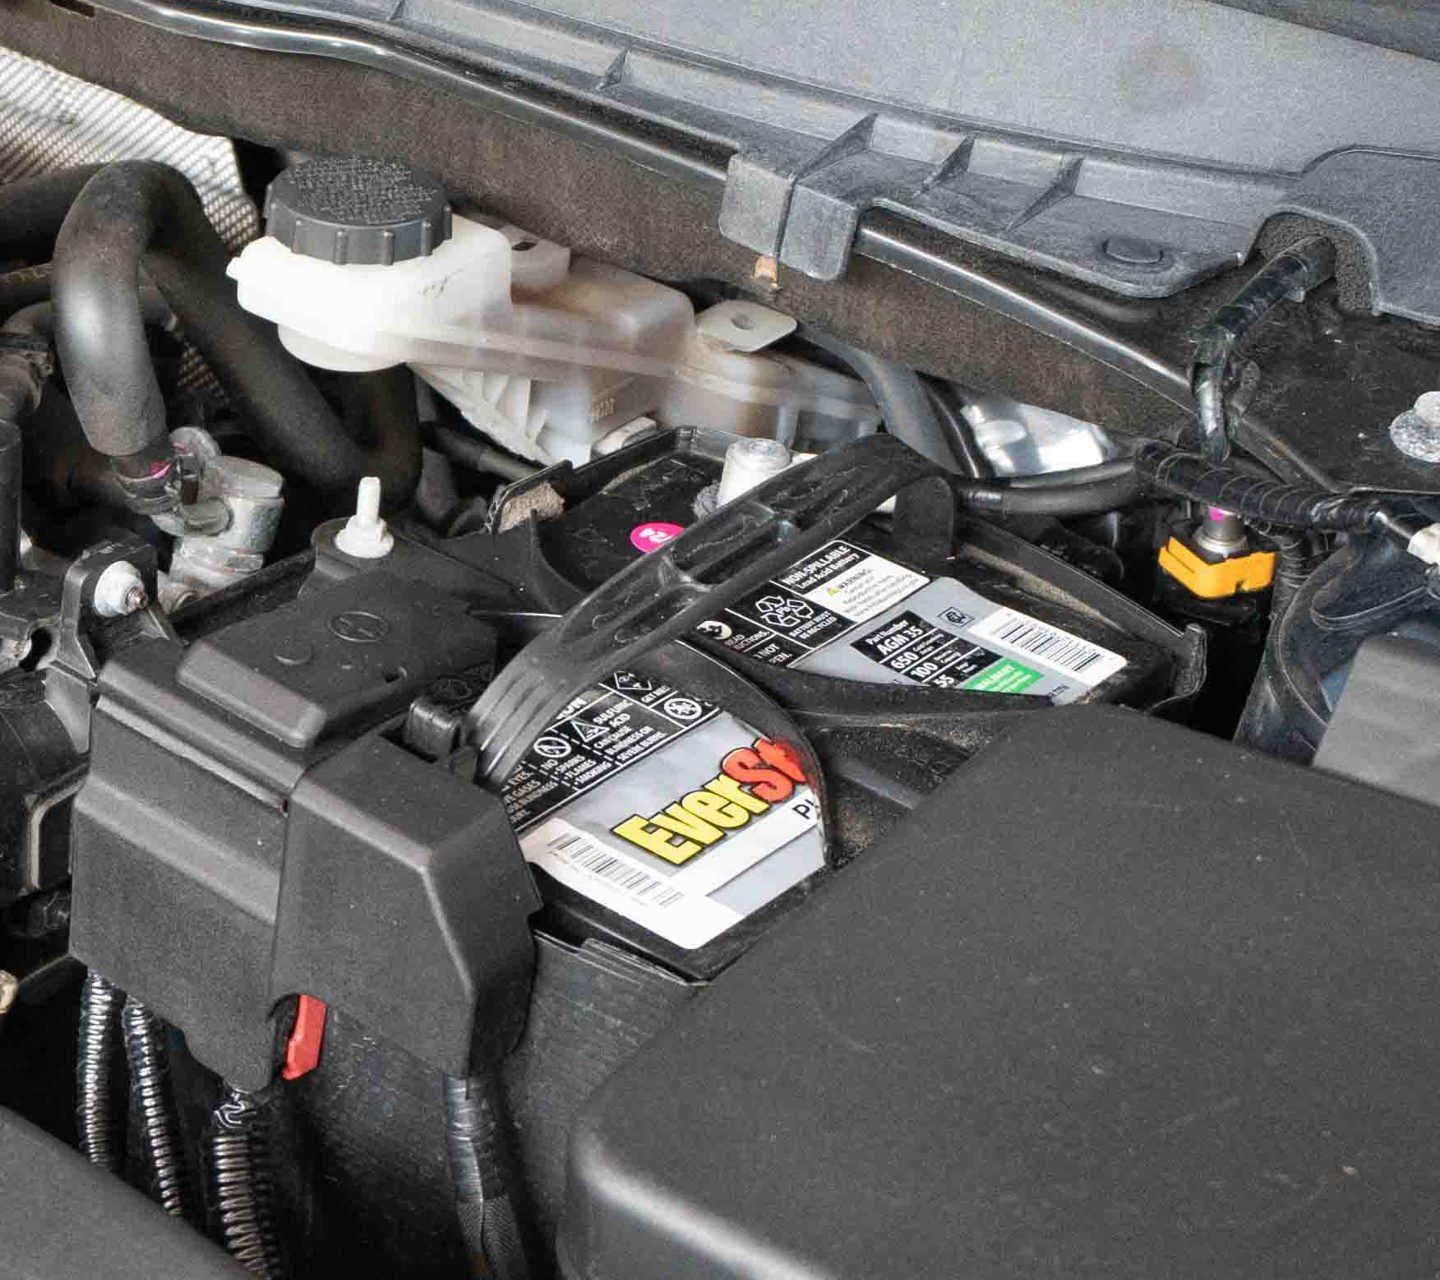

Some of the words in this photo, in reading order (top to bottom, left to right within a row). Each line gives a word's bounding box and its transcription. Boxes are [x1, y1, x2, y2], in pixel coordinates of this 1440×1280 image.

[782, 545, 851, 586] NON-SPILLABLE
[829, 552, 860, 571] Battery
[865, 634, 883, 646] Part
[880, 619, 909, 637] Number
[876, 633, 909, 655] AGM
[903, 625, 924, 639] 35
[890, 651, 919, 669] 650
[910, 661, 938, 678] 100
[933, 673, 955, 689] 55
[610, 736, 808, 867] EverSt
